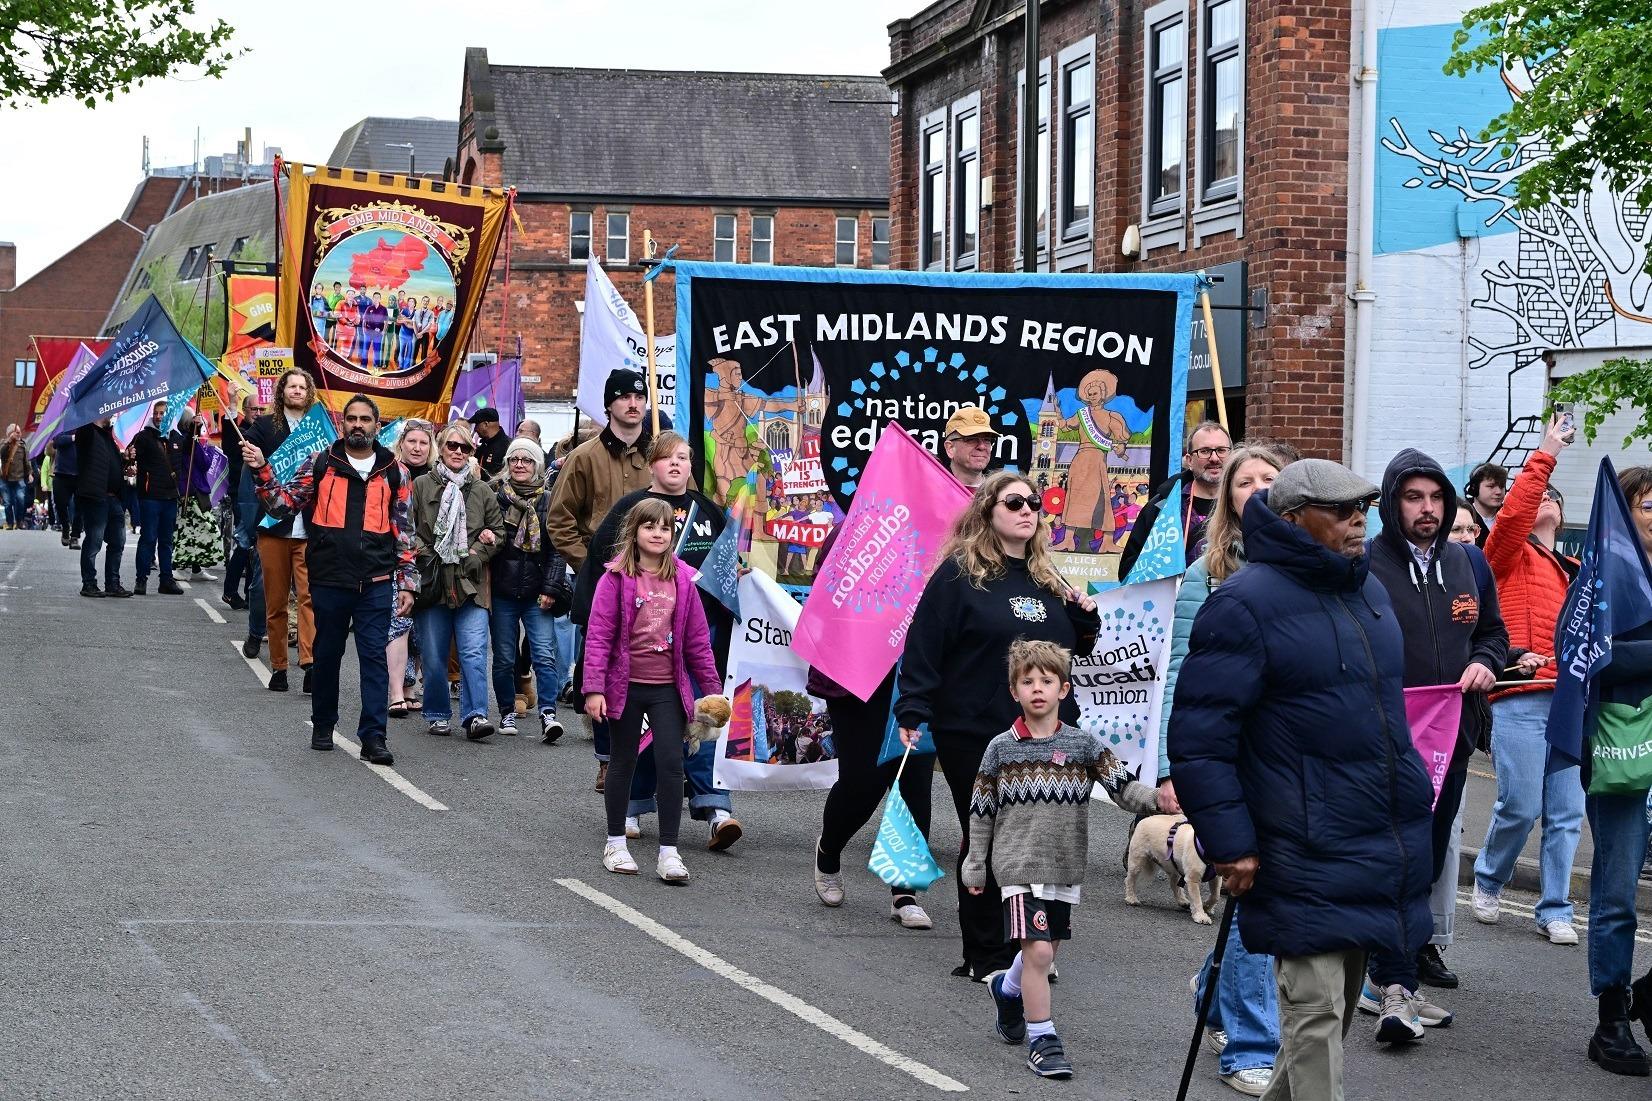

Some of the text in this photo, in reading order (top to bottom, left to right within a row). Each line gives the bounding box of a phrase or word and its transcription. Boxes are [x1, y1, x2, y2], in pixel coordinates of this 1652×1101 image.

[347, 211, 440, 239] GMB MIDLANDS
[249, 302, 273, 317] GMB
[712, 312, 1154, 366] EAST MIDLANDS REGION
[258, 359, 284, 368] NO TO
[259, 378, 273, 387] NO
[260, 387, 272, 395] TO
[770, 451, 793, 464] neu
[784, 459, 822, 473] UNITY
[799, 471, 811, 481] IS
[783, 478, 828, 490] STRENGTH
[1063, 556, 1098, 566] ALICE
[744, 617, 793, 647] Stan
[1091, 686, 1148, 707] union
